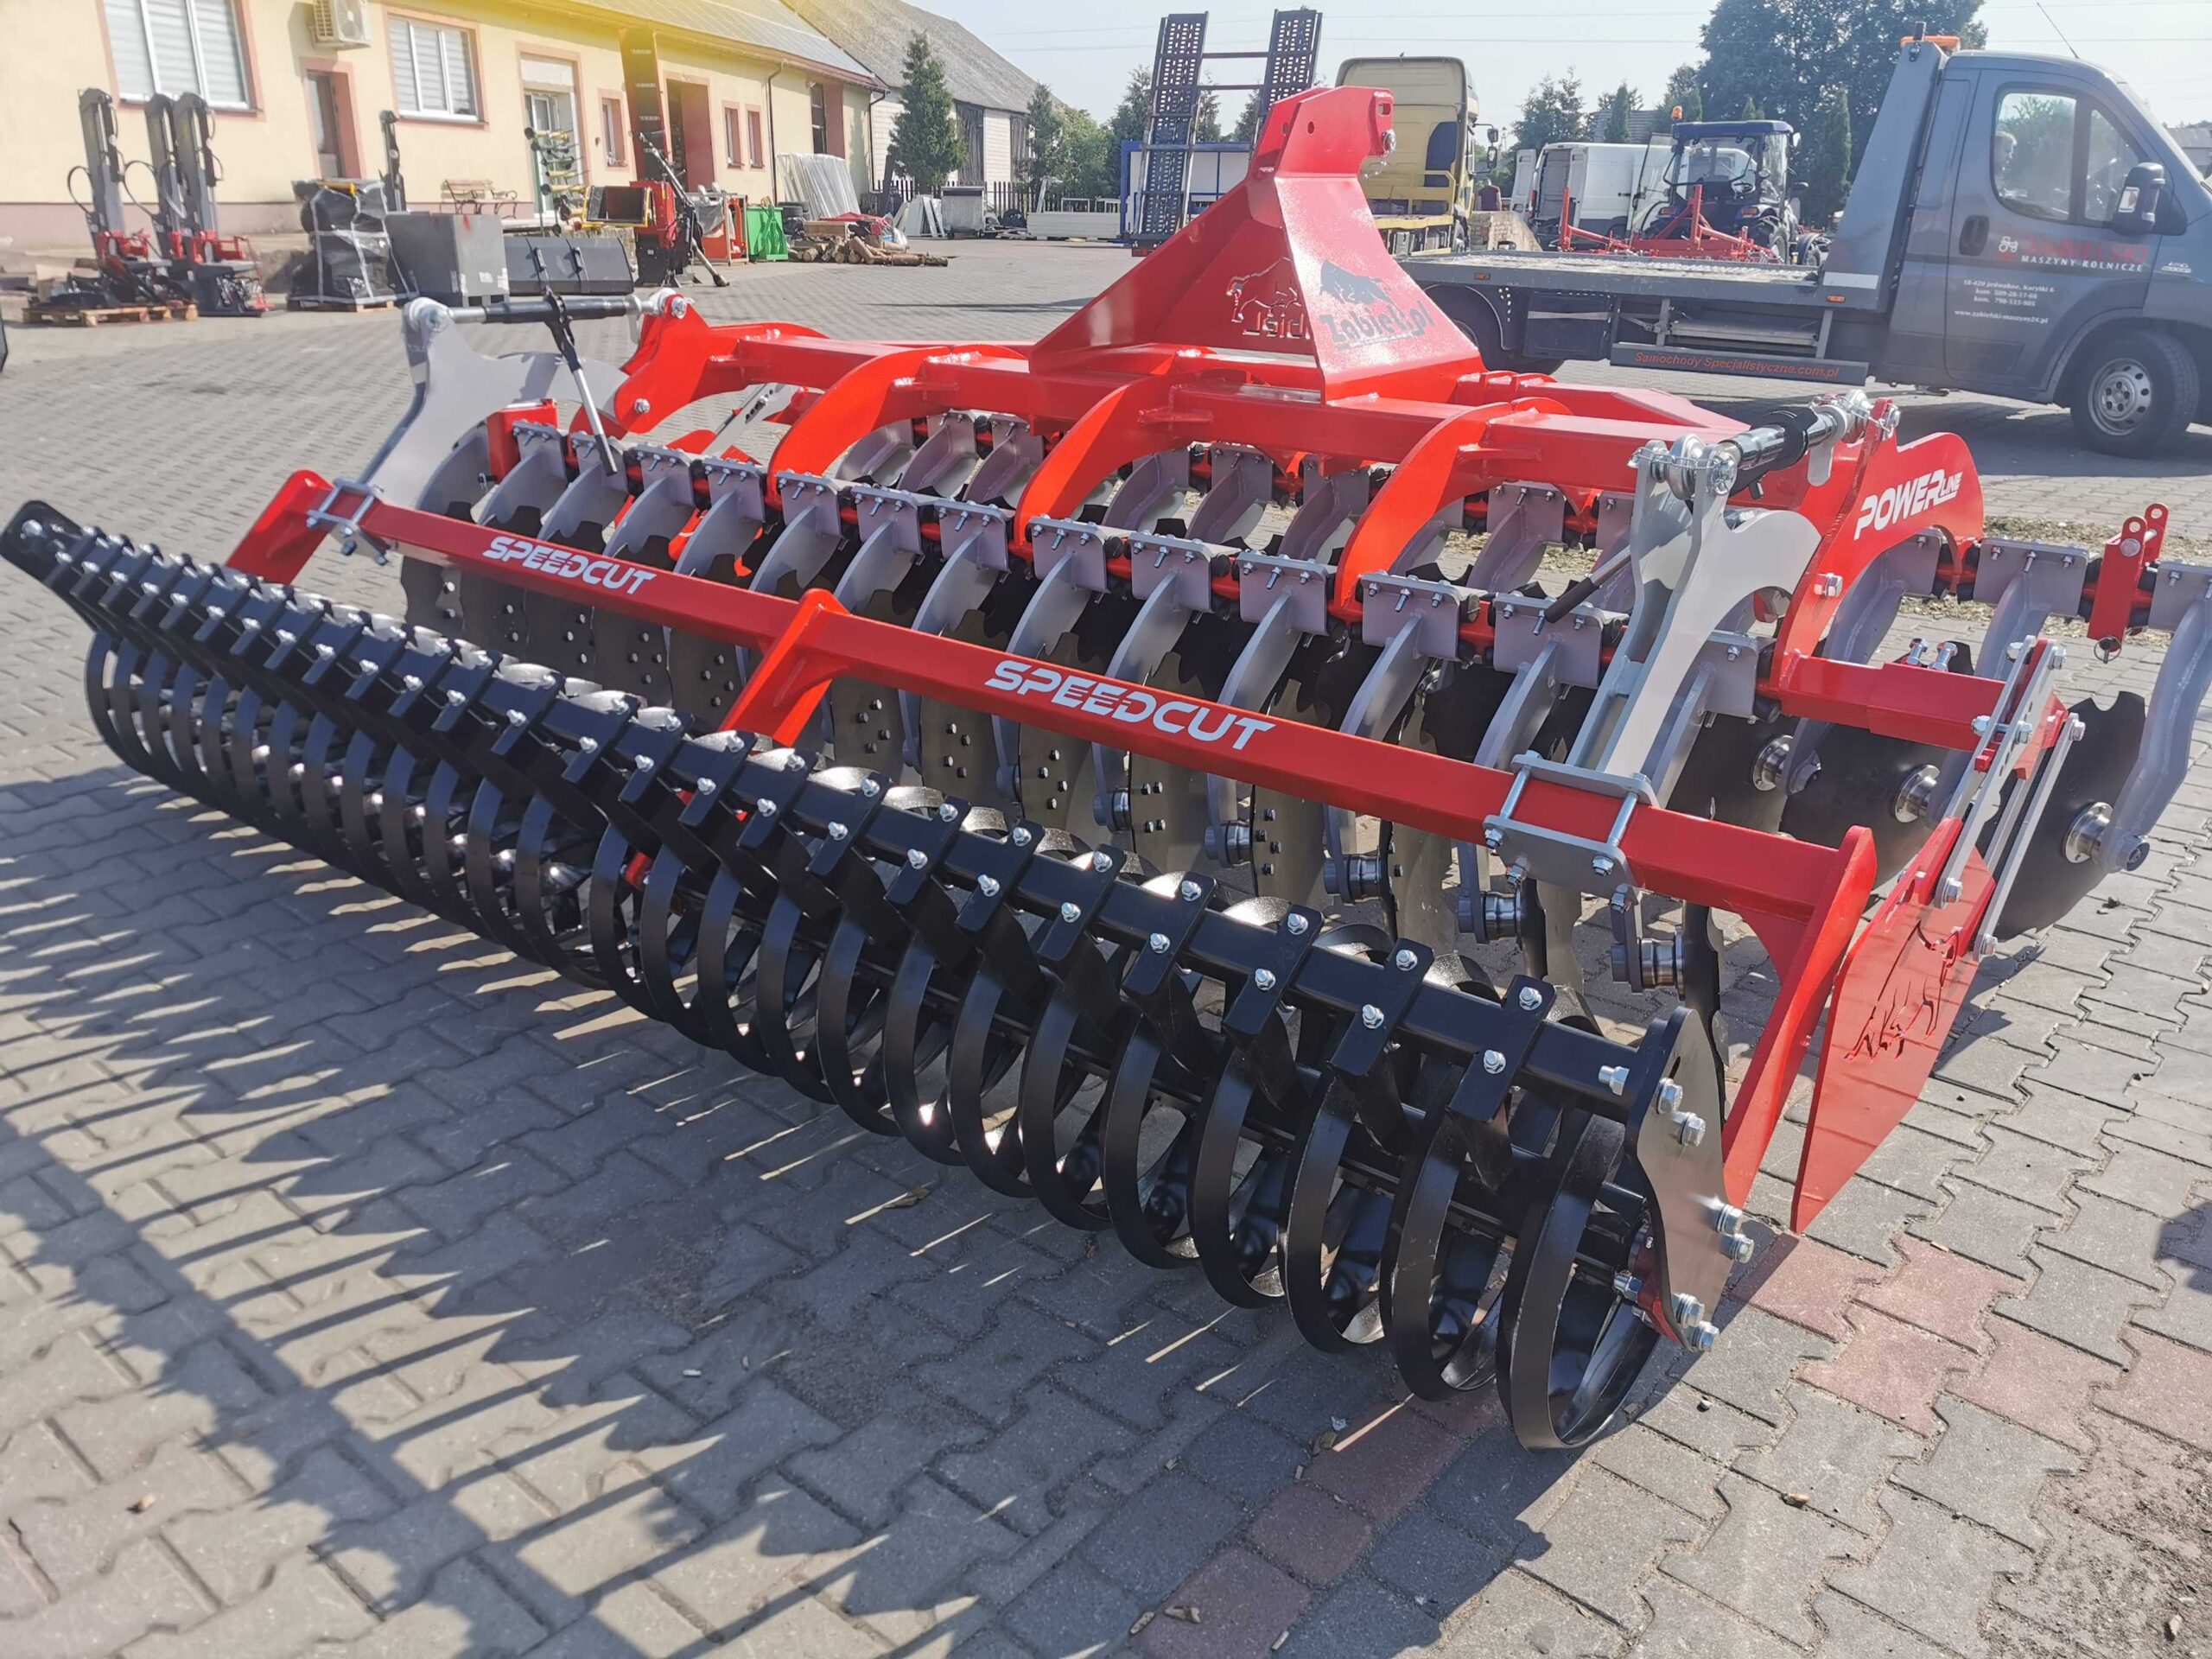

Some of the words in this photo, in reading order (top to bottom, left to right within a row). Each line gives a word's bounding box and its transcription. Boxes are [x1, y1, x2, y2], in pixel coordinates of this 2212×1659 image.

[2021, 255, 2076, 267] MASZYNY
[2082, 260, 2144, 272] ROLNICZE
[1634, 352, 1702, 369] Samochody
[1705, 357, 1840, 378] Specjalistyczne.com.pl
[482, 535, 657, 594] SPEEDCUT
[984, 660, 1276, 751] SPEEDCUT
